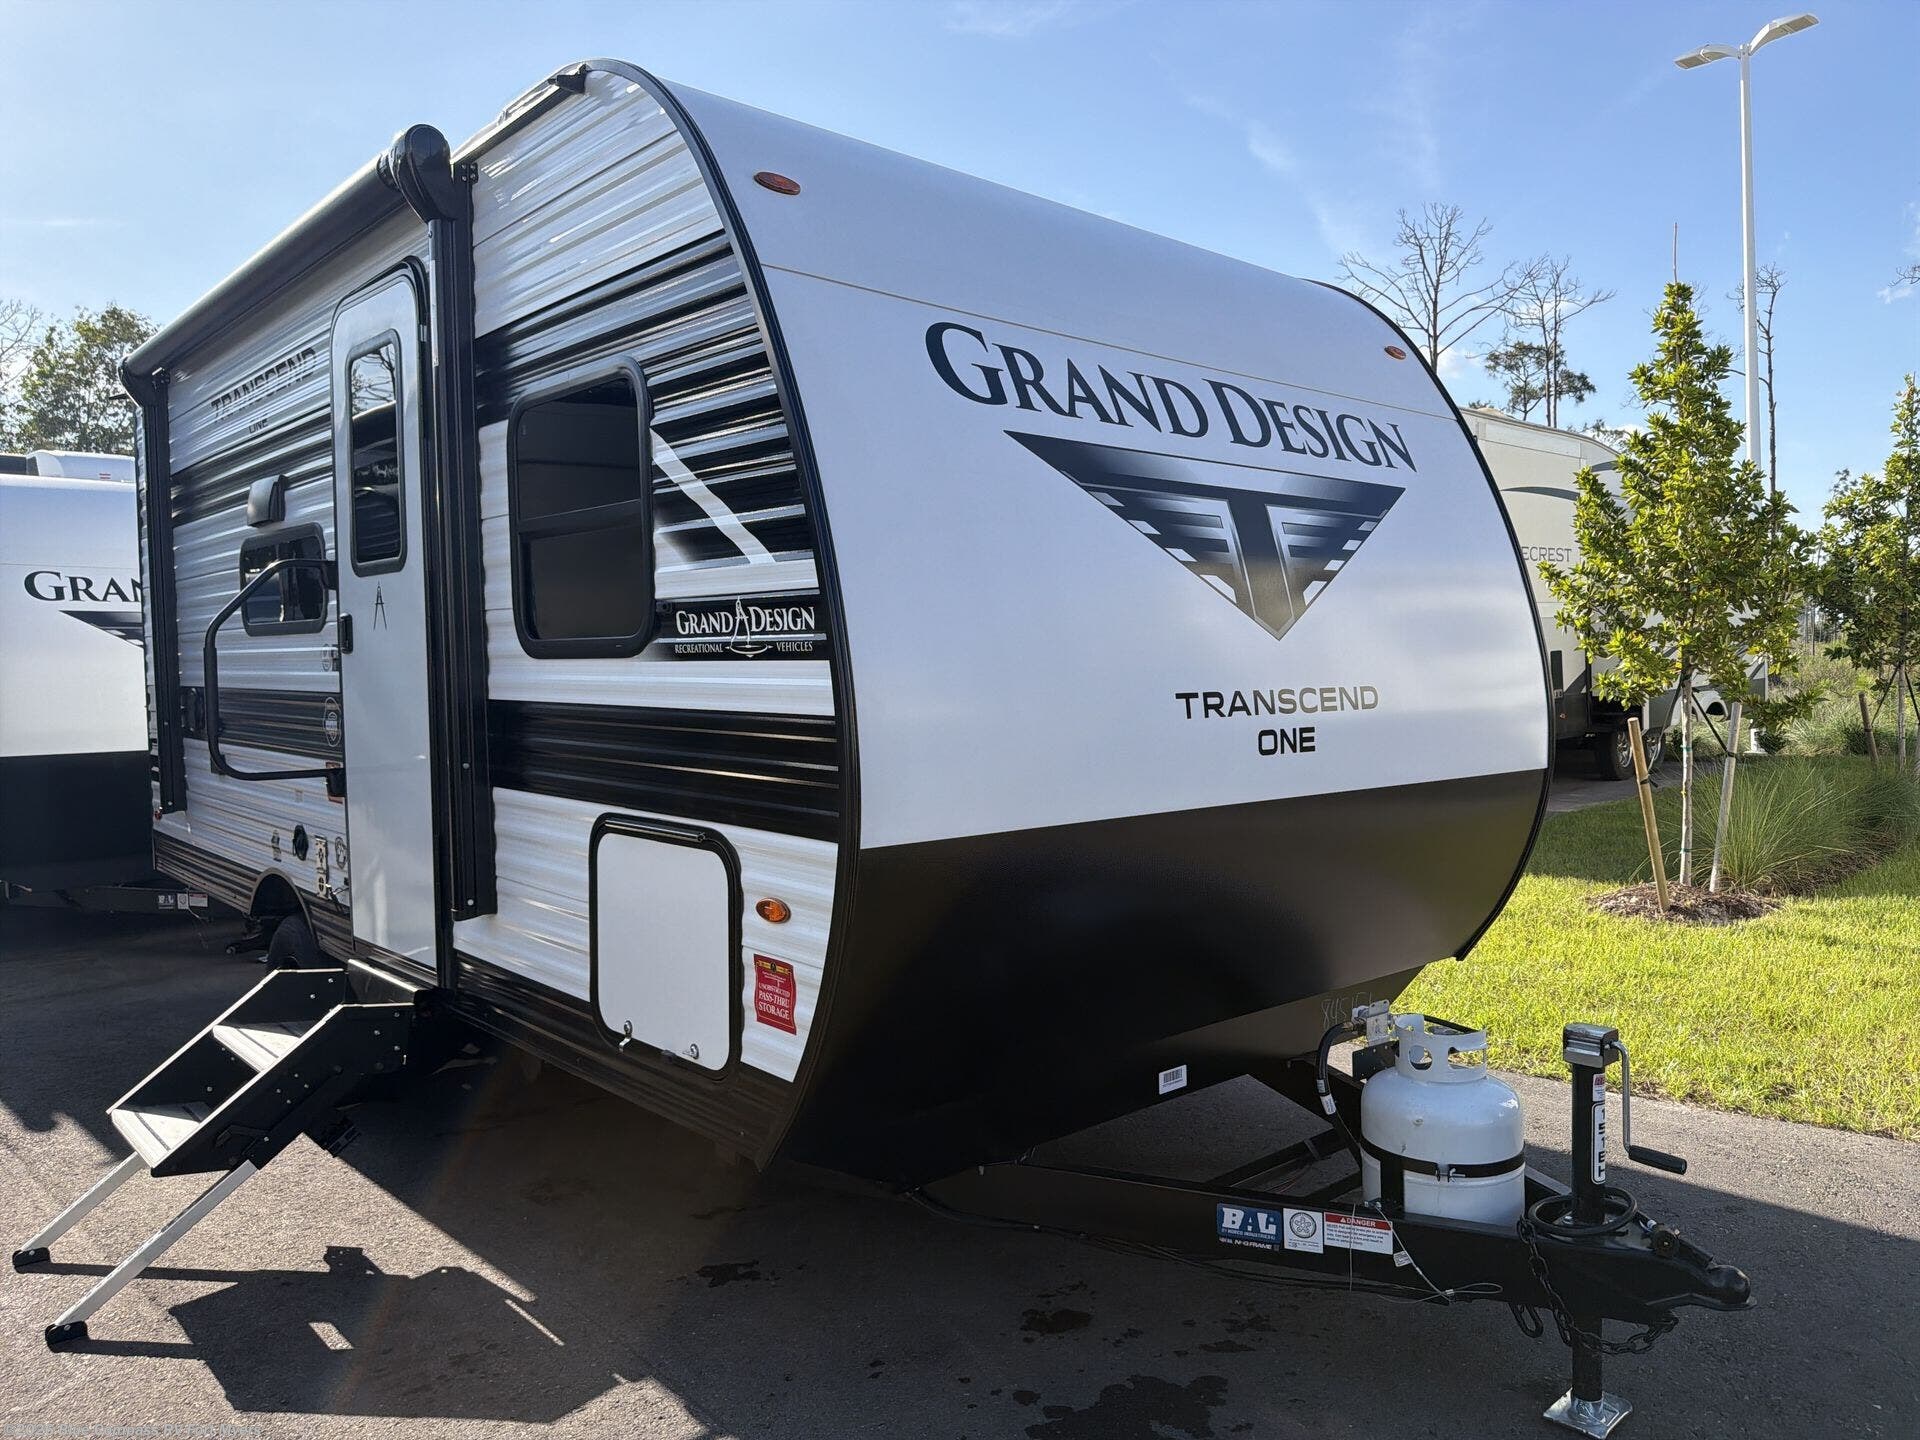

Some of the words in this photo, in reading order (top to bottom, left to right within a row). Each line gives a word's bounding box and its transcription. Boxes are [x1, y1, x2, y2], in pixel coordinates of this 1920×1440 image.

[211, 347, 317, 424] TRANSCEND
[925, 321, 1209, 438] GRAND
[1202, 378, 1418, 473] DESIGN
[675, 610, 734, 635] GRAND
[748, 606, 816, 633] DESIGN
[674, 643, 724, 654] RECREATIONAL
[776, 641, 814, 652] VEHICLES
[1174, 685, 1379, 720] TRANSCEND
[1258, 726, 1317, 756] ONE
[759, 990, 790, 1008] PASS-THRU
[759, 1001, 790, 1020] STORAGE
[1222, 1207, 1277, 1235] BAL
[1346, 1217, 1376, 1228] DANGER
